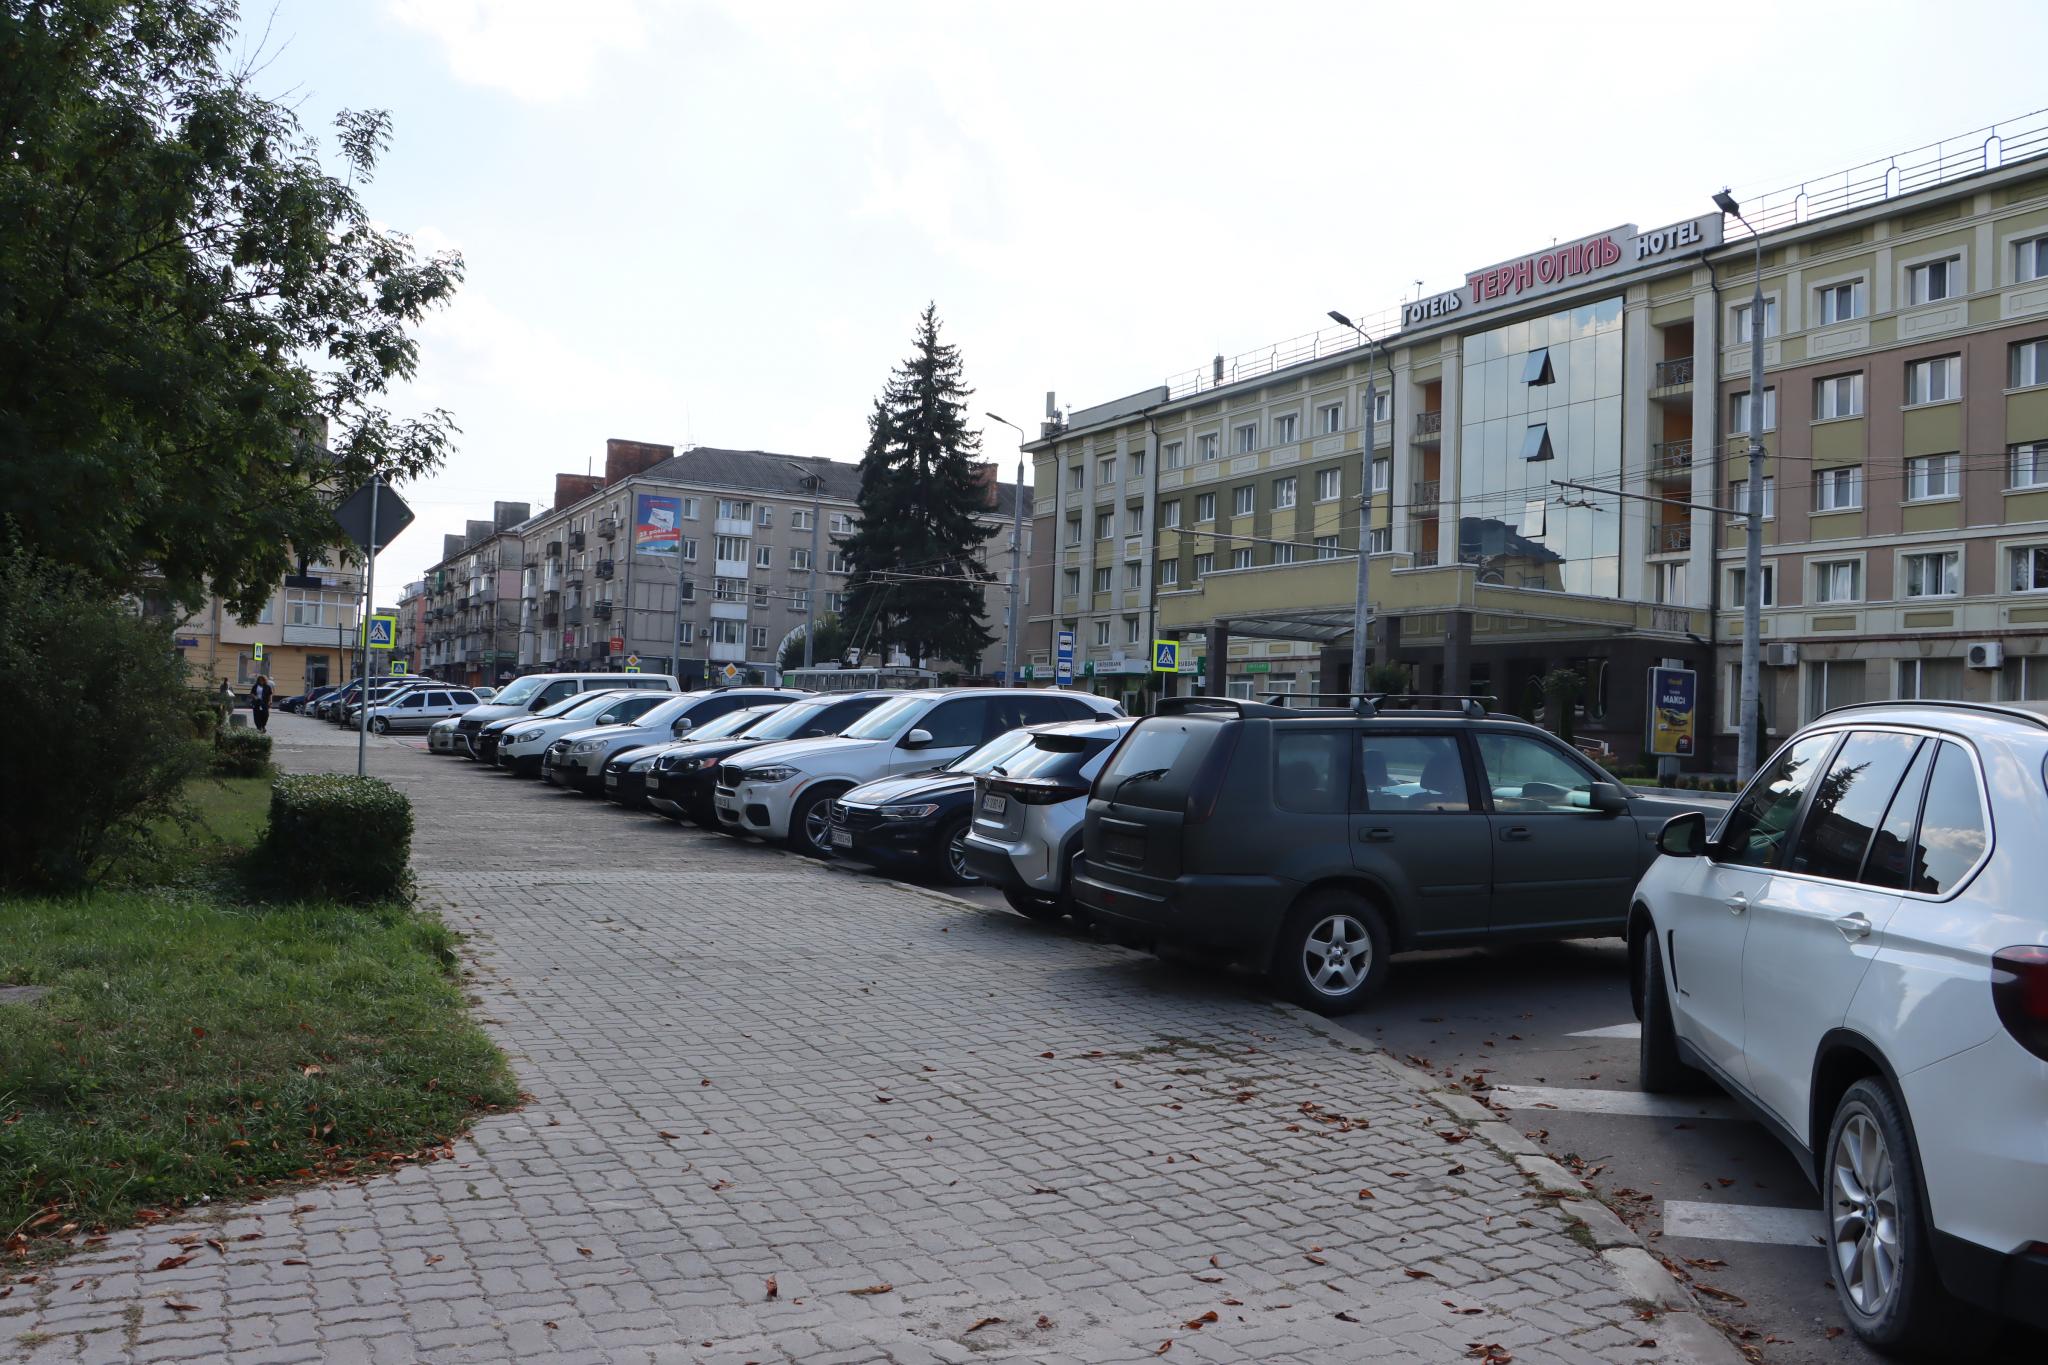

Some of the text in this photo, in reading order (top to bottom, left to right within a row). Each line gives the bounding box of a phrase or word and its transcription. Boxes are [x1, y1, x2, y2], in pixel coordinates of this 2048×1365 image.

[1635, 221, 1702, 260] HOTEL
[1402, 235, 1621, 326] ГОТЕЛЬ ТЕРНОПІЛЬ
